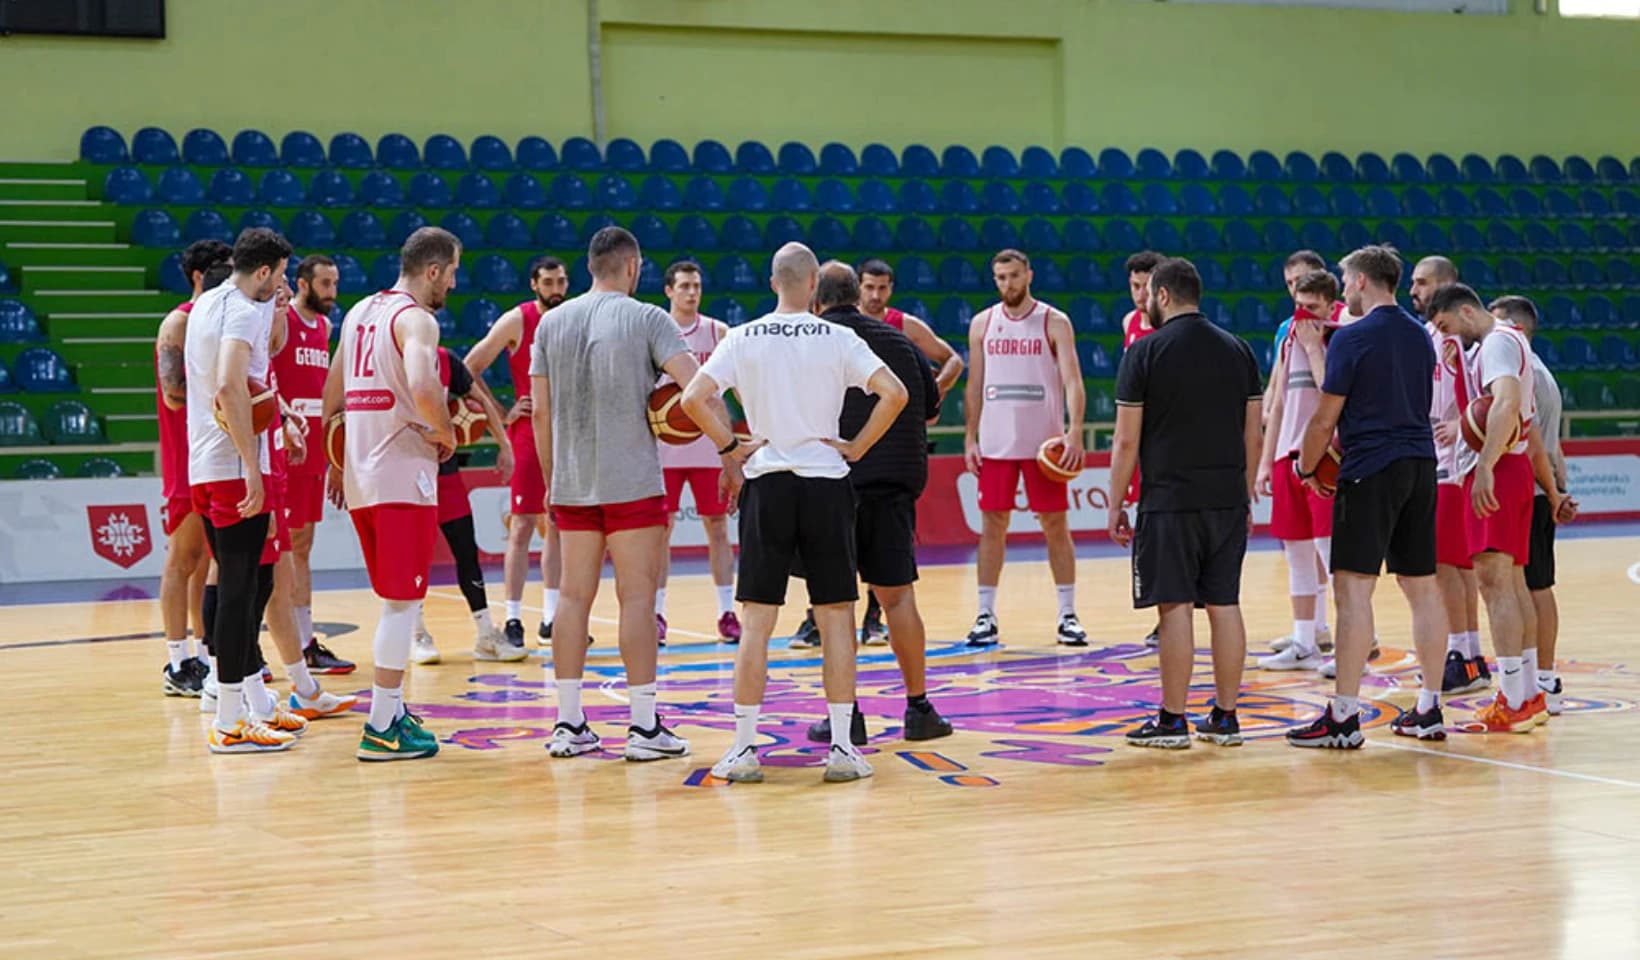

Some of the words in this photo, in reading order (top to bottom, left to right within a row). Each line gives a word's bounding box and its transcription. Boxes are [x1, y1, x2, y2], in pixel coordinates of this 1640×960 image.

[745, 323, 830, 336] macron
[354, 325, 376, 377] 12
[988, 338, 1042, 355] GEORGIA
